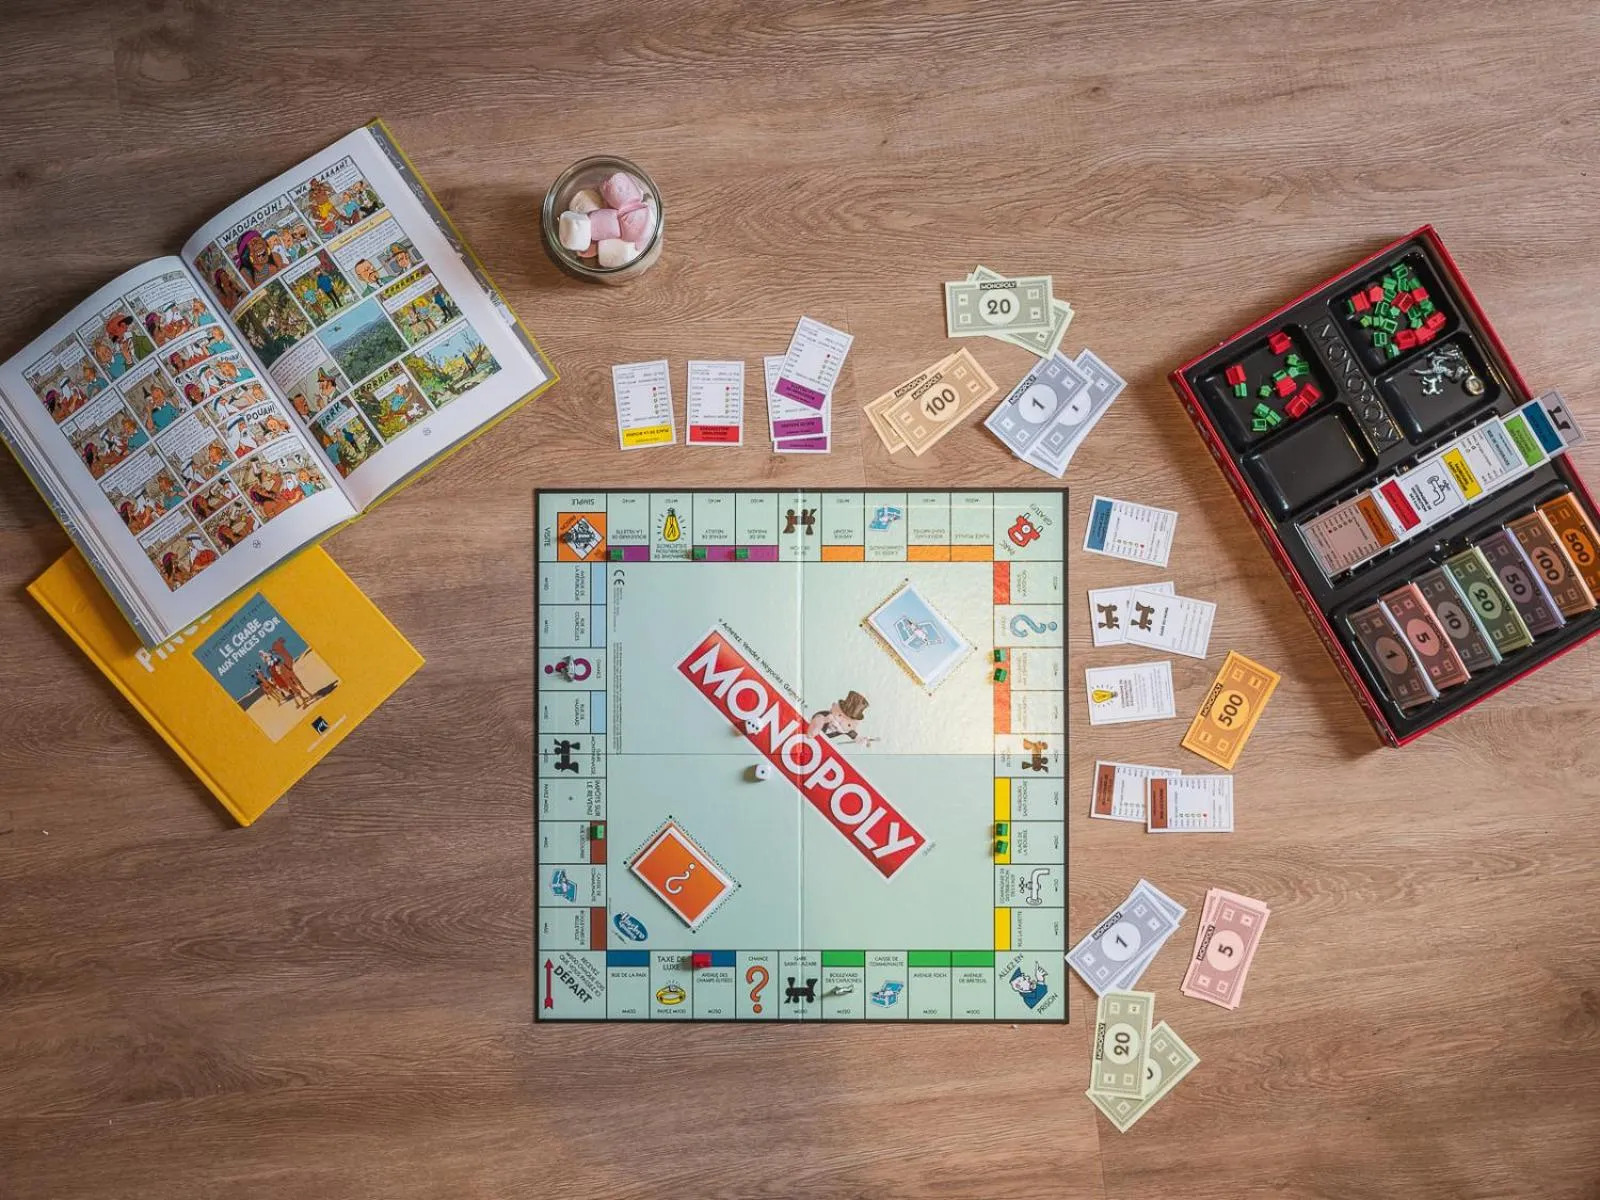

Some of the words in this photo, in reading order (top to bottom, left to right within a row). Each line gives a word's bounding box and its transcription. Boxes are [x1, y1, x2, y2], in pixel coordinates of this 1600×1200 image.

[980, 281, 1016, 290] MONOPOLY
[987, 299, 1011, 314] 20
[911, 372, 943, 400] MONOPOLY
[926, 388, 955, 415] 100
[1032, 398, 1044, 410] 1
[571, 498, 595, 506] SIMPLE
[1567, 532, 1590, 563] 500
[1537, 550, 1560, 582] 100
[1505, 572, 1526, 596] 50
[1474, 589, 1495, 612] 20
[1444, 610, 1461, 630] 10
[217, 659, 235, 676] AUX
[233, 637, 260, 663] PINCES
[259, 617, 281, 638] D'OR
[219, 644, 234, 658] LE
[231, 618, 262, 648] CRABE
[1415, 632, 1429, 643] 5
[1385, 650, 1397, 660] 1
[1200, 682, 1223, 717] MONOPOLY
[1218, 694, 1243, 727] 500
[688, 643, 916, 859] MONOPOLY
[586, 781, 593, 789] LE
[1092, 911, 1123, 940] MONOPOLY
[1116, 935, 1127, 948] 1
[1196, 924, 1216, 962] MONOPOLY
[1218, 944, 1233, 958] 5
[998, 962, 1015, 979] ALLEZ
[1013, 953, 1024, 964] EN
[1037, 992, 1058, 1015] PRISON
[1114, 1032, 1130, 1056] 20
